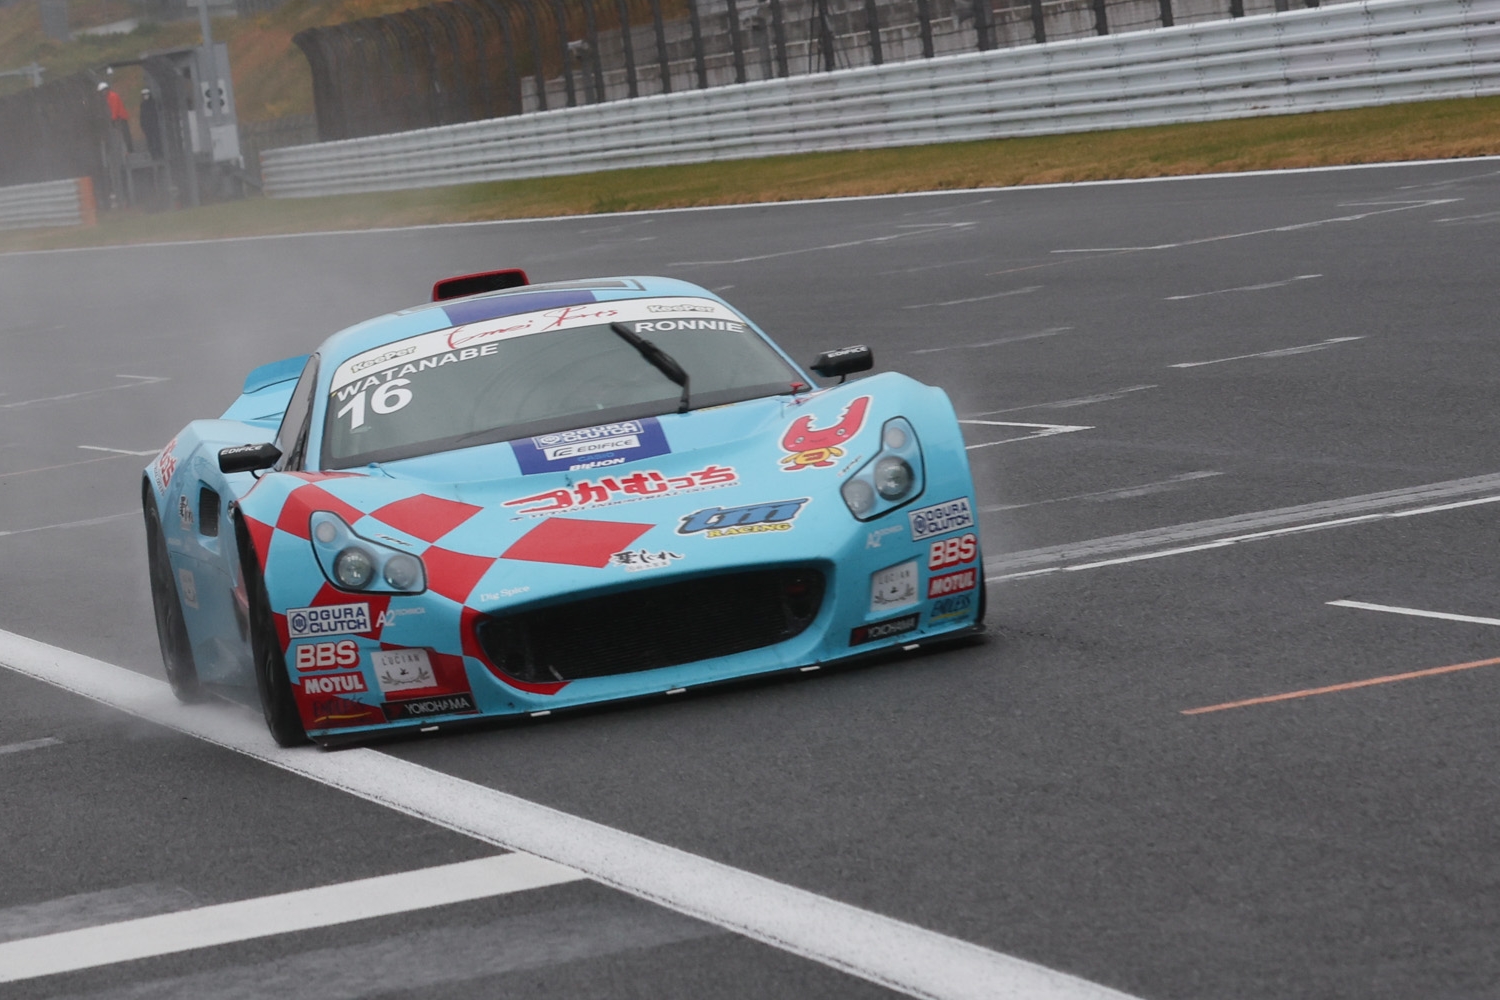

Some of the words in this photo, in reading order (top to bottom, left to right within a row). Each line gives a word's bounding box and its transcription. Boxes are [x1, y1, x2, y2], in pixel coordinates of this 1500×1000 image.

[635, 320, 744, 334] RONNIE
[336, 342, 499, 402] WATANABE
[338, 378, 413, 430] 16
[563, 425, 638, 442] CLUTCH
[220, 445, 263, 456] EDIFICE
[577, 439, 633, 453] EDIFICE
[577, 452, 615, 462] CASIO
[503, 465, 737, 514] つかむっち
[676, 497, 810, 535] tm
[926, 501, 968, 521] OGURA
[707, 522, 791, 538] RACING
[929, 513, 971, 533] CLUTCH
[929, 533, 977, 570] BBS
[930, 571, 975, 596] MOTUL
[308, 606, 366, 621] OGURA
[375, 610, 397, 628] A2
[310, 618, 368, 633] CLUTCH
[296, 640, 359, 671] BBS
[305, 674, 364, 694] MOTUL
[404, 697, 470, 715] YOKOHAMA
